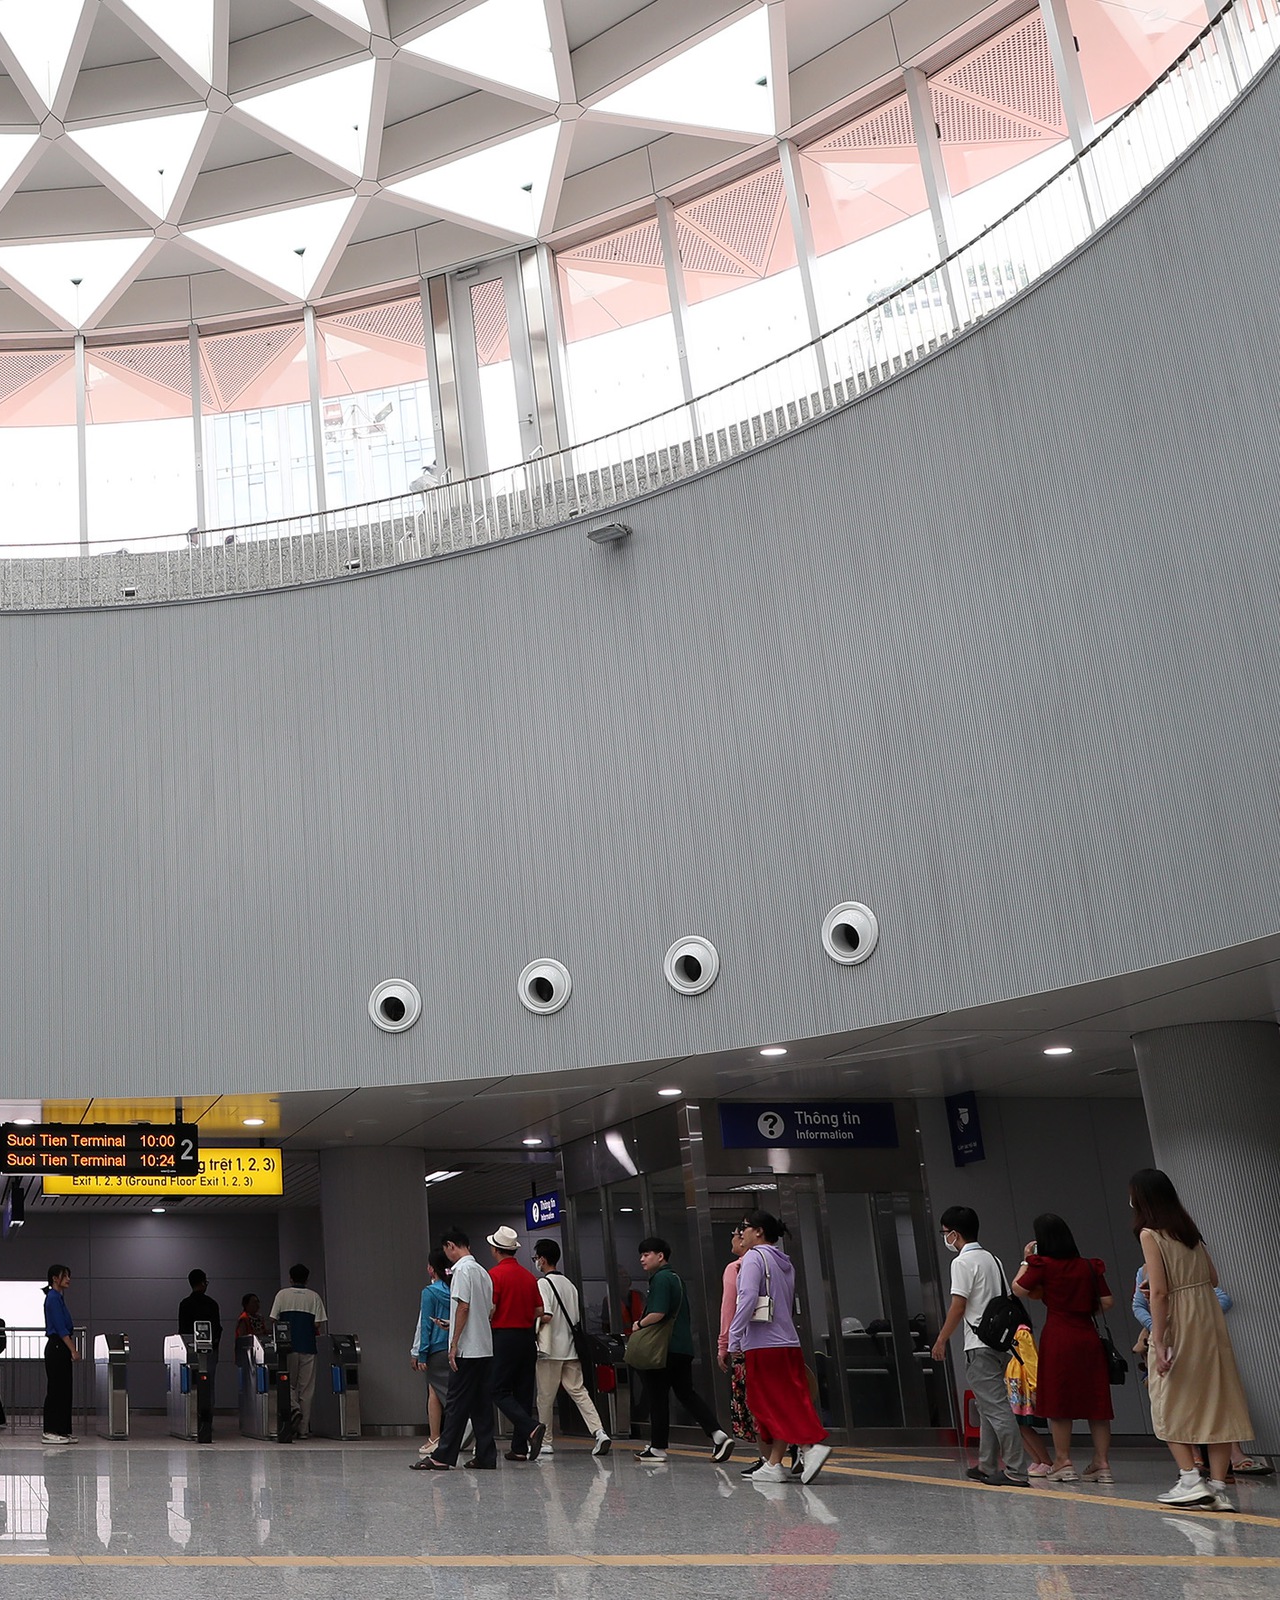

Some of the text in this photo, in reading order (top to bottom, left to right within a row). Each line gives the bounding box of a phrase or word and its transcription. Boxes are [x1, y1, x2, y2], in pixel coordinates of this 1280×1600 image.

[794, 1111, 861, 1128] Thông tin
[7, 1134, 176, 1148] Suoi Tien Terminal 10:00
[796, 1129, 854, 1140] Information
[180, 1139, 194, 1161] 2
[7, 1154, 176, 1168] Suoi Tien Terminal 10:24
[209, 1158, 233, 1174] trệt
[263, 1158, 276, 1173] 3)
[72, 1176, 91, 1187] Exit
[116, 1176, 123, 1187] 3
[125, 1176, 167, 1188] (Ground
[170, 1176, 198, 1187] Floor
[201, 1176, 219, 1187] Exit
[244, 1177, 253, 1188] 3)
